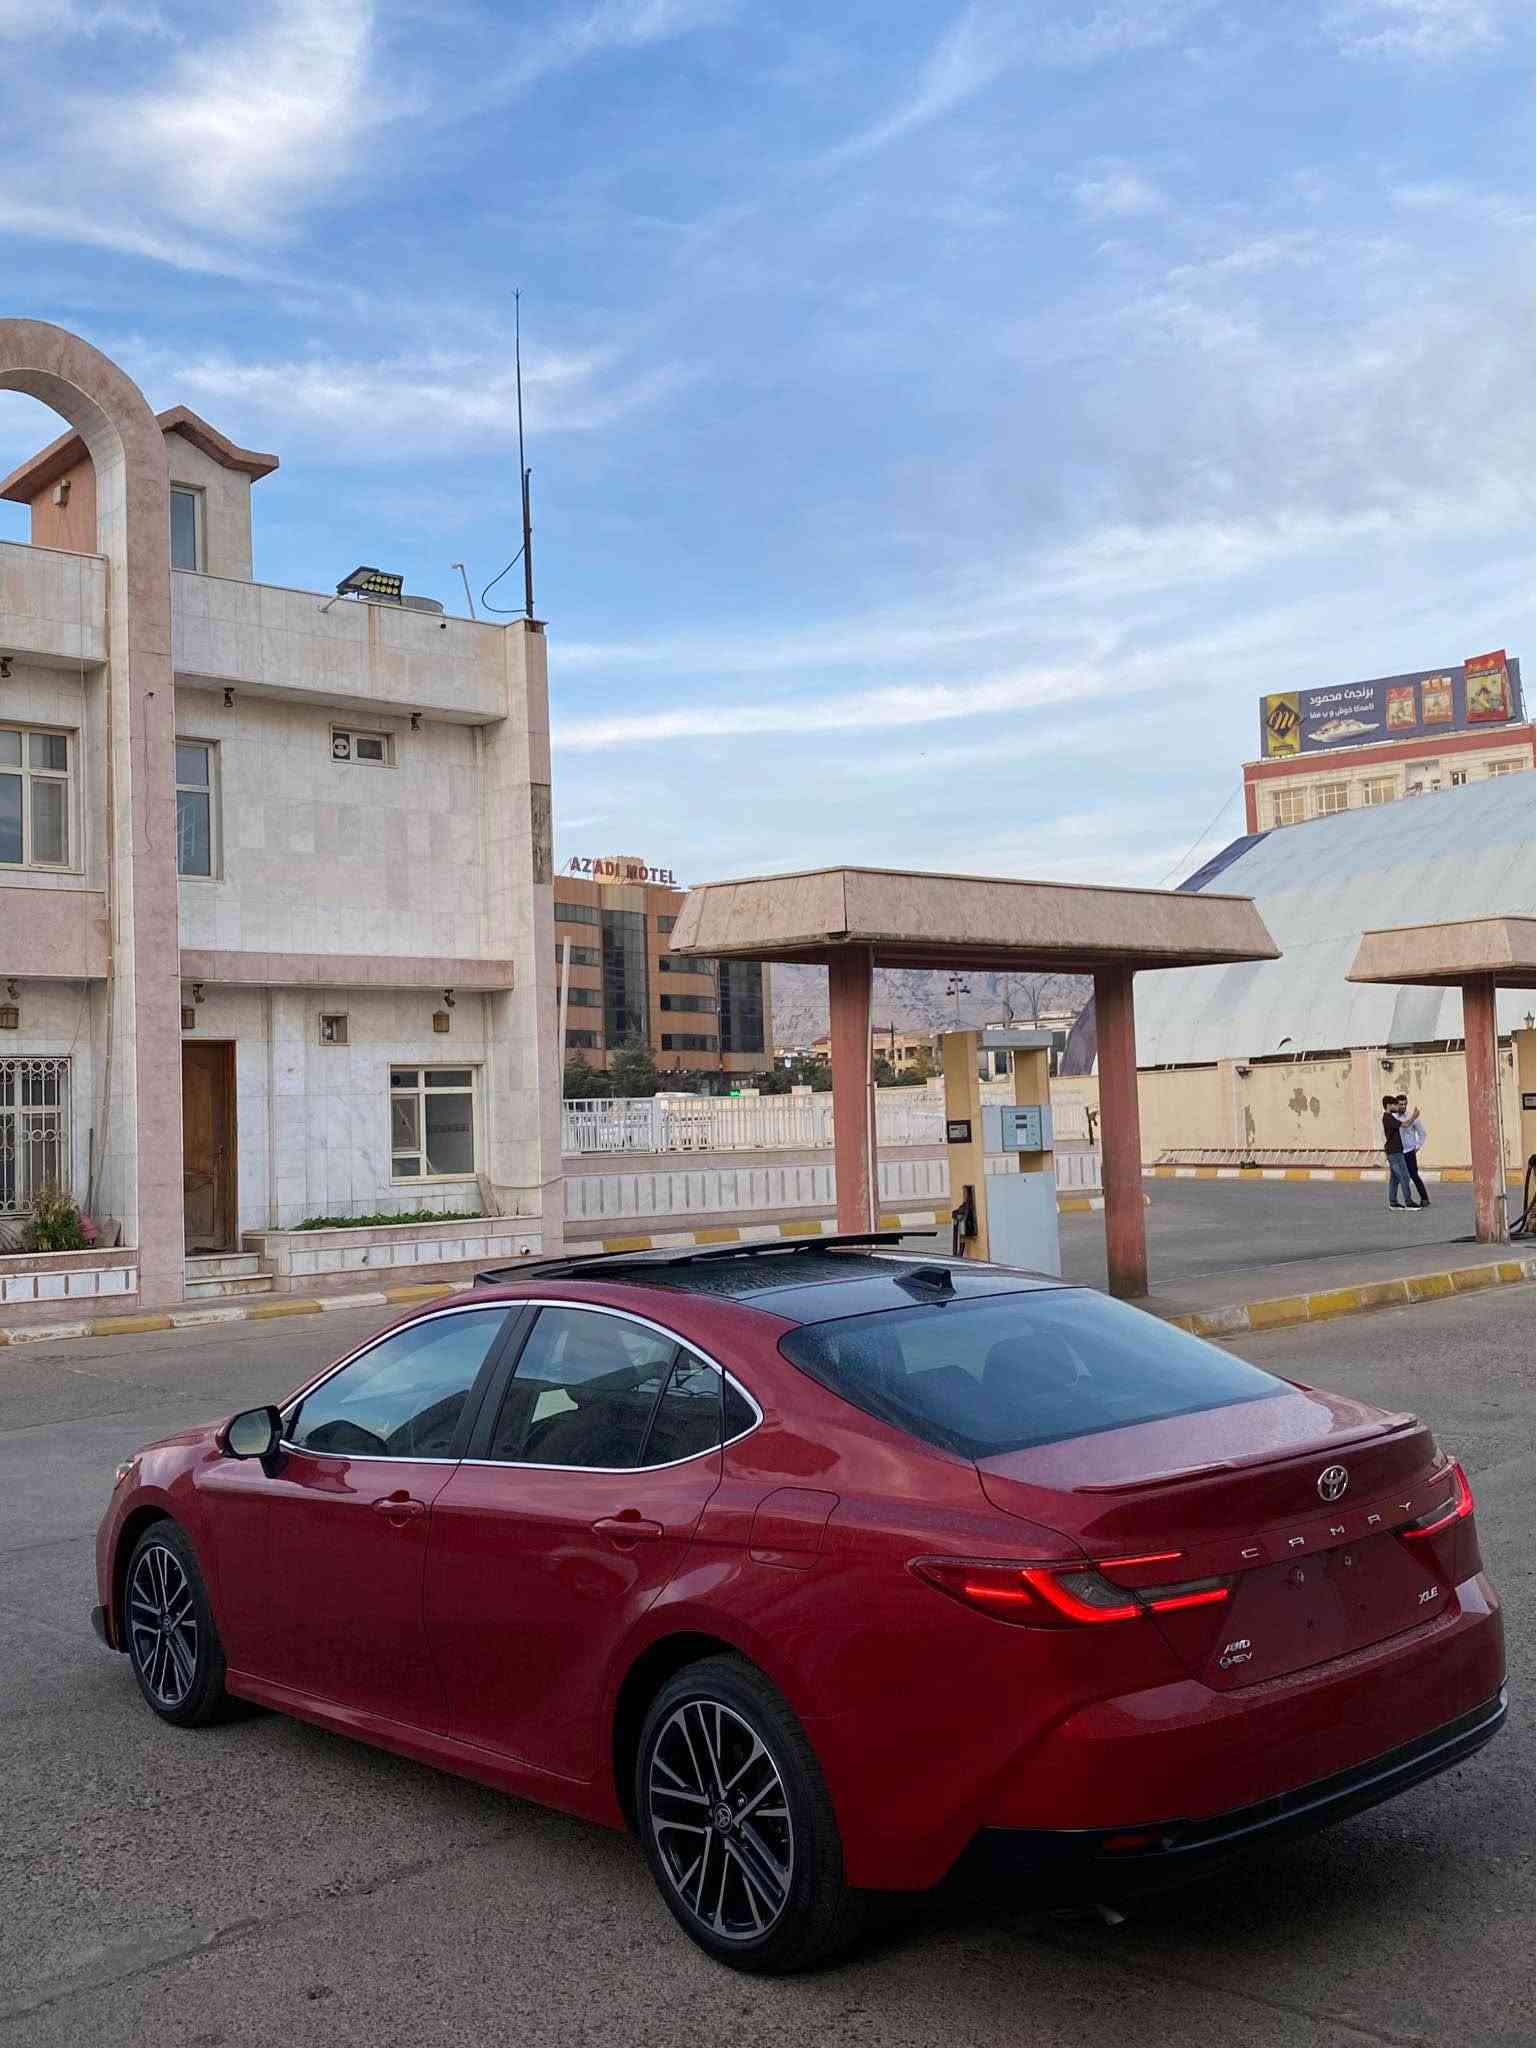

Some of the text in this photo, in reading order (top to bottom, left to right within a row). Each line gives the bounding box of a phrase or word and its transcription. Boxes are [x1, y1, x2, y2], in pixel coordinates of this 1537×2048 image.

[570, 856, 619, 877] AZADI
[1241, 1502, 1412, 1558] CAMRY
[1418, 1585, 1439, 1605] XLE
